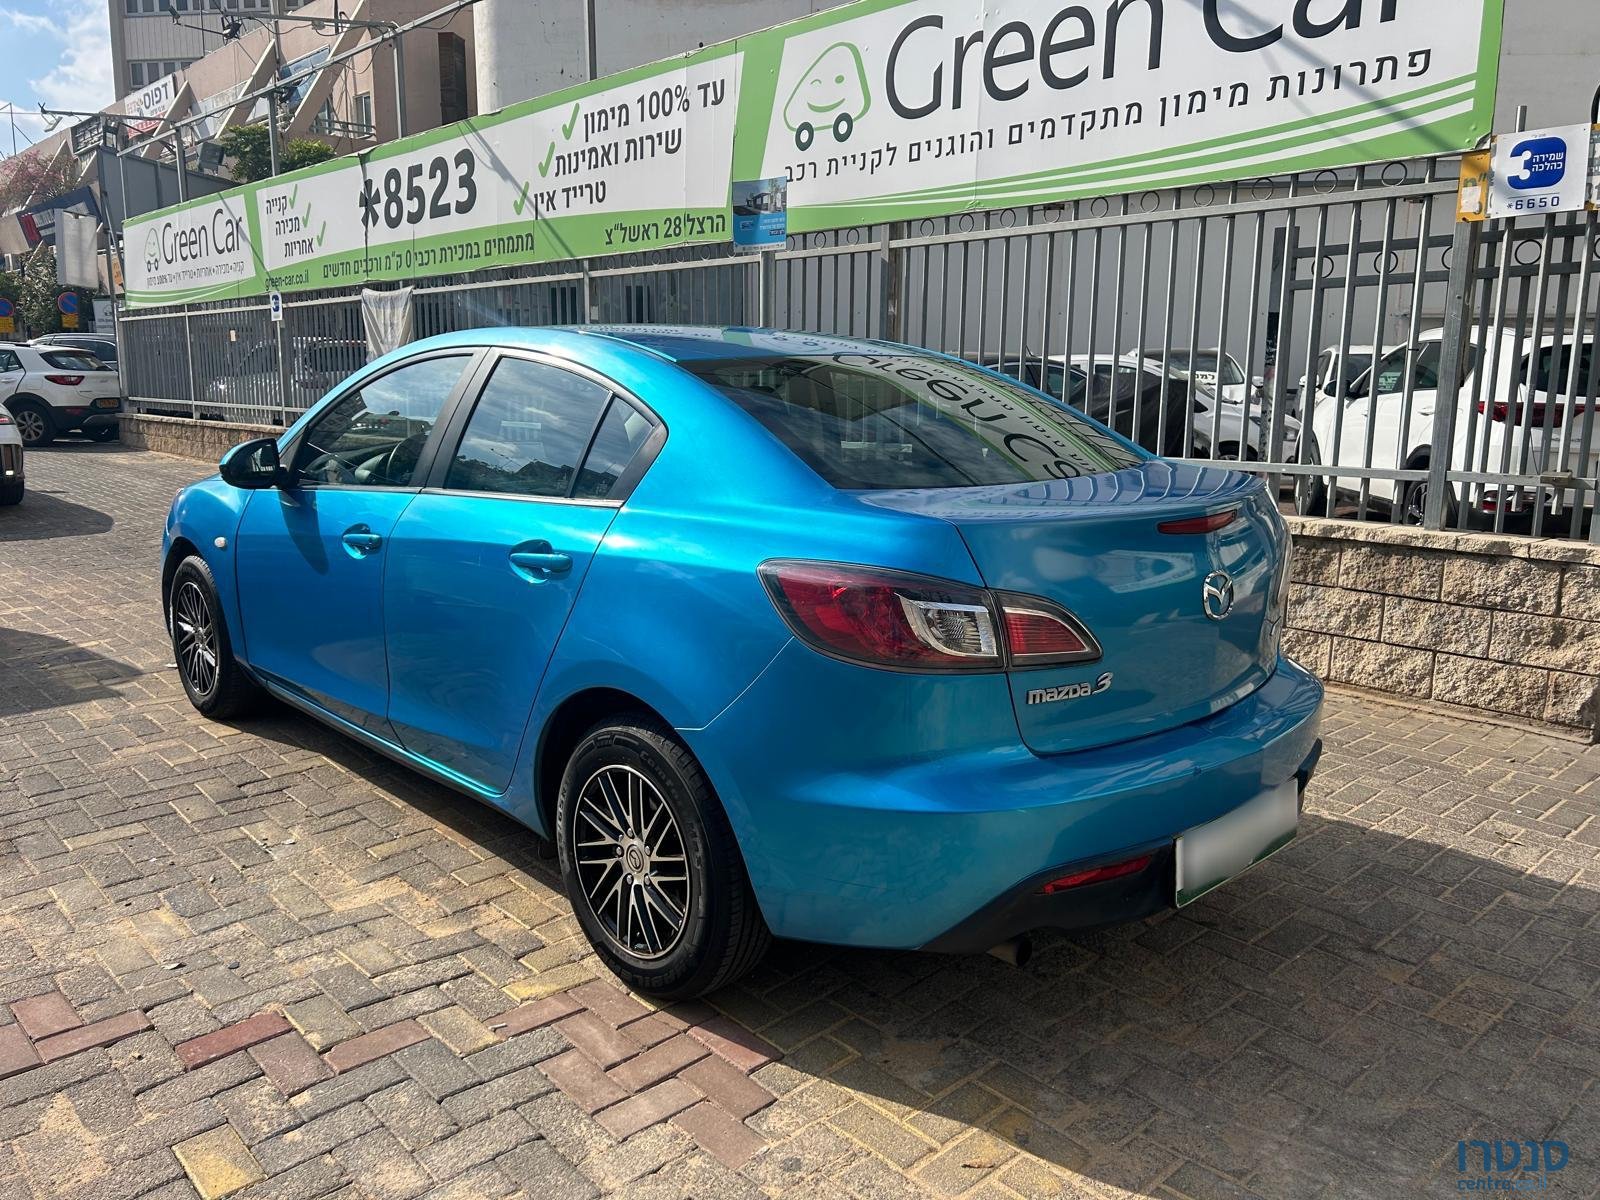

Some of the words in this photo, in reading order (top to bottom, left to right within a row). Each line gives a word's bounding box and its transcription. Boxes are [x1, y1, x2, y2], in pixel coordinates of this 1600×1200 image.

[885, 0, 1164, 120] Green
[1266, 48, 1432, 101] פתרונות
[143, 84, 169, 110] דפוס
[637, 83, 690, 123] 100%
[698, 78, 726, 107] עד
[1159, 82, 1249, 127] מימון
[583, 102, 630, 142] מימון
[1007, 101, 1143, 146] מתקדמים
[624, 127, 682, 164] שירות
[908, 128, 995, 163] והוגנים
[1532, 151, 1564, 163] שמירה
[554, 141, 619, 178] ואמינות
[784, 161, 818, 183] רכב
[825, 142, 899, 178] לקניית
[1531, 161, 1563, 173] כהלכה
[266, 195, 288, 215] קנייה
[533, 188, 557, 220] אין
[562, 180, 607, 209] טרייד
[162, 222, 209, 265] Green
[212, 208, 242, 255] Car
[275, 217, 300, 236] מכירה
[663, 216, 683, 239] 28
[684, 213, 726, 238] הרצל
[284, 237, 314, 258] אחריות
[413, 247, 436, 267] רכבי
[440, 241, 481, 264] במכירת
[485, 232, 535, 257] מתמחים
[323, 261, 350, 278] חדשים
[354, 258, 382, 275] ורכבים
[265, 271, 309, 289] green-car.co.il
